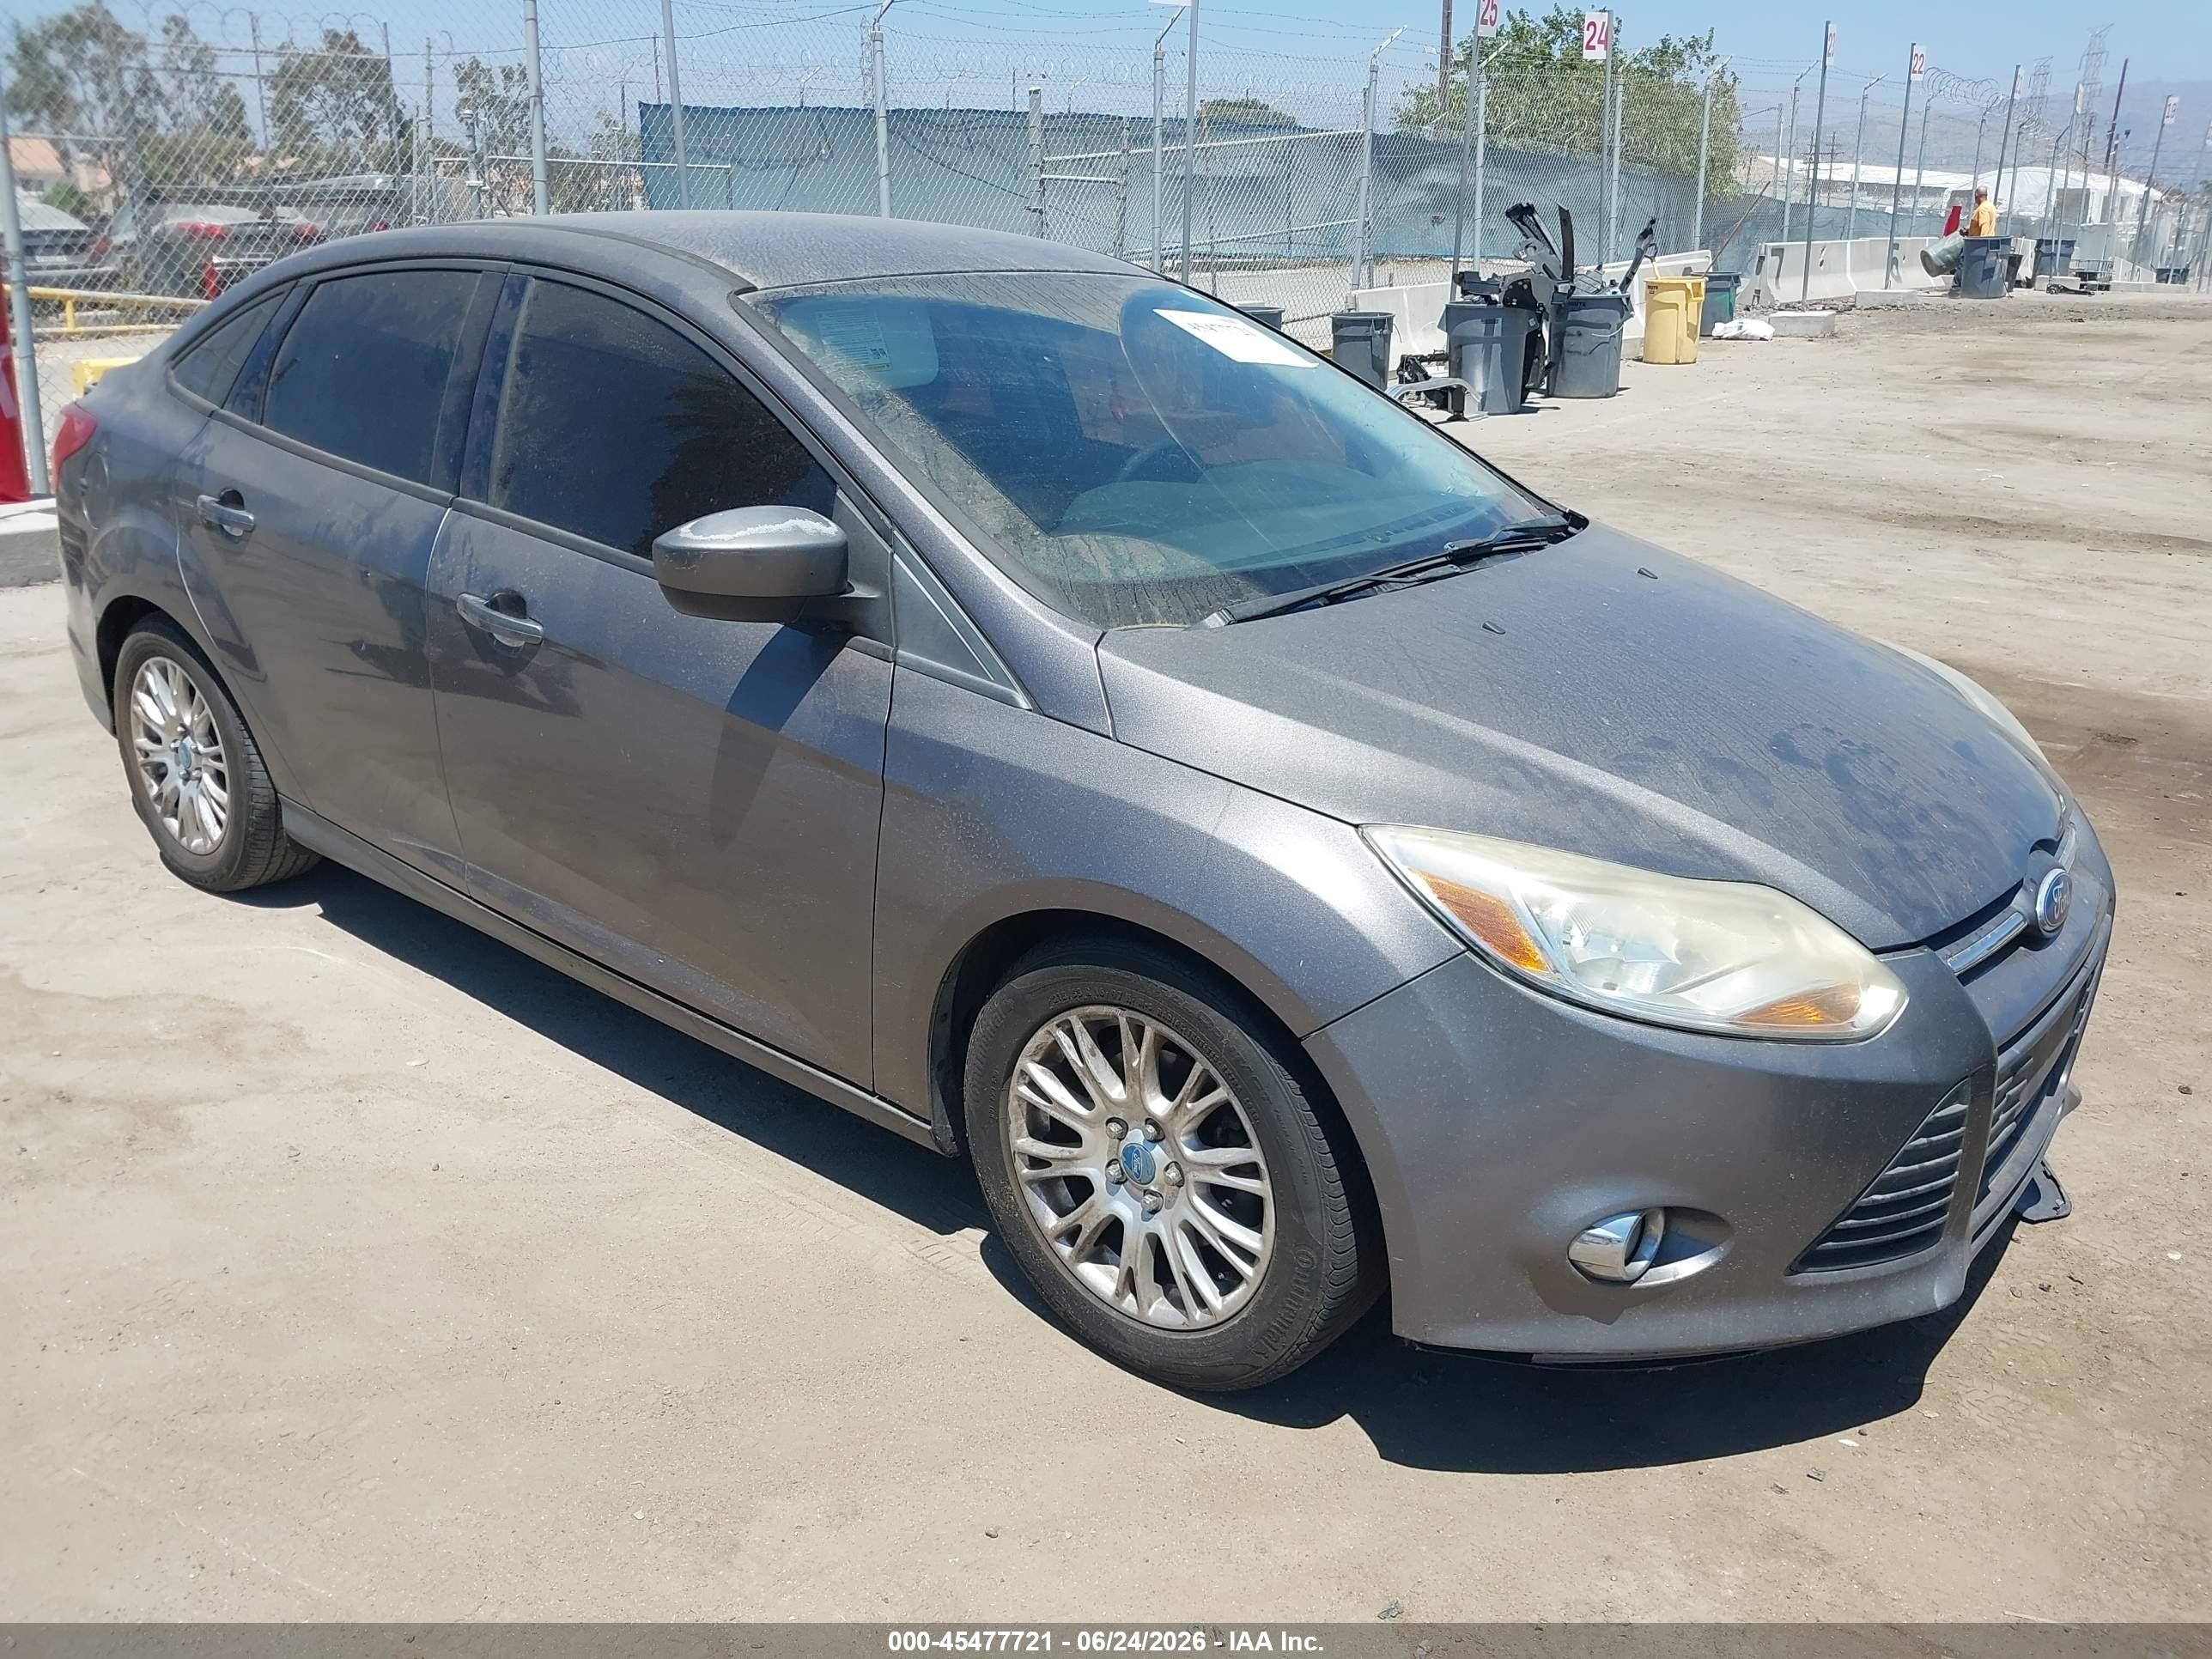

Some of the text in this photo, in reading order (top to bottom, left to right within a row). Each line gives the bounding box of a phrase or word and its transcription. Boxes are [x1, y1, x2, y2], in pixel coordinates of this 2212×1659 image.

[1480, 0, 1498, 27] 25
[1584, 21, 1608, 51] 24
[1911, 53, 1924, 75] 22
